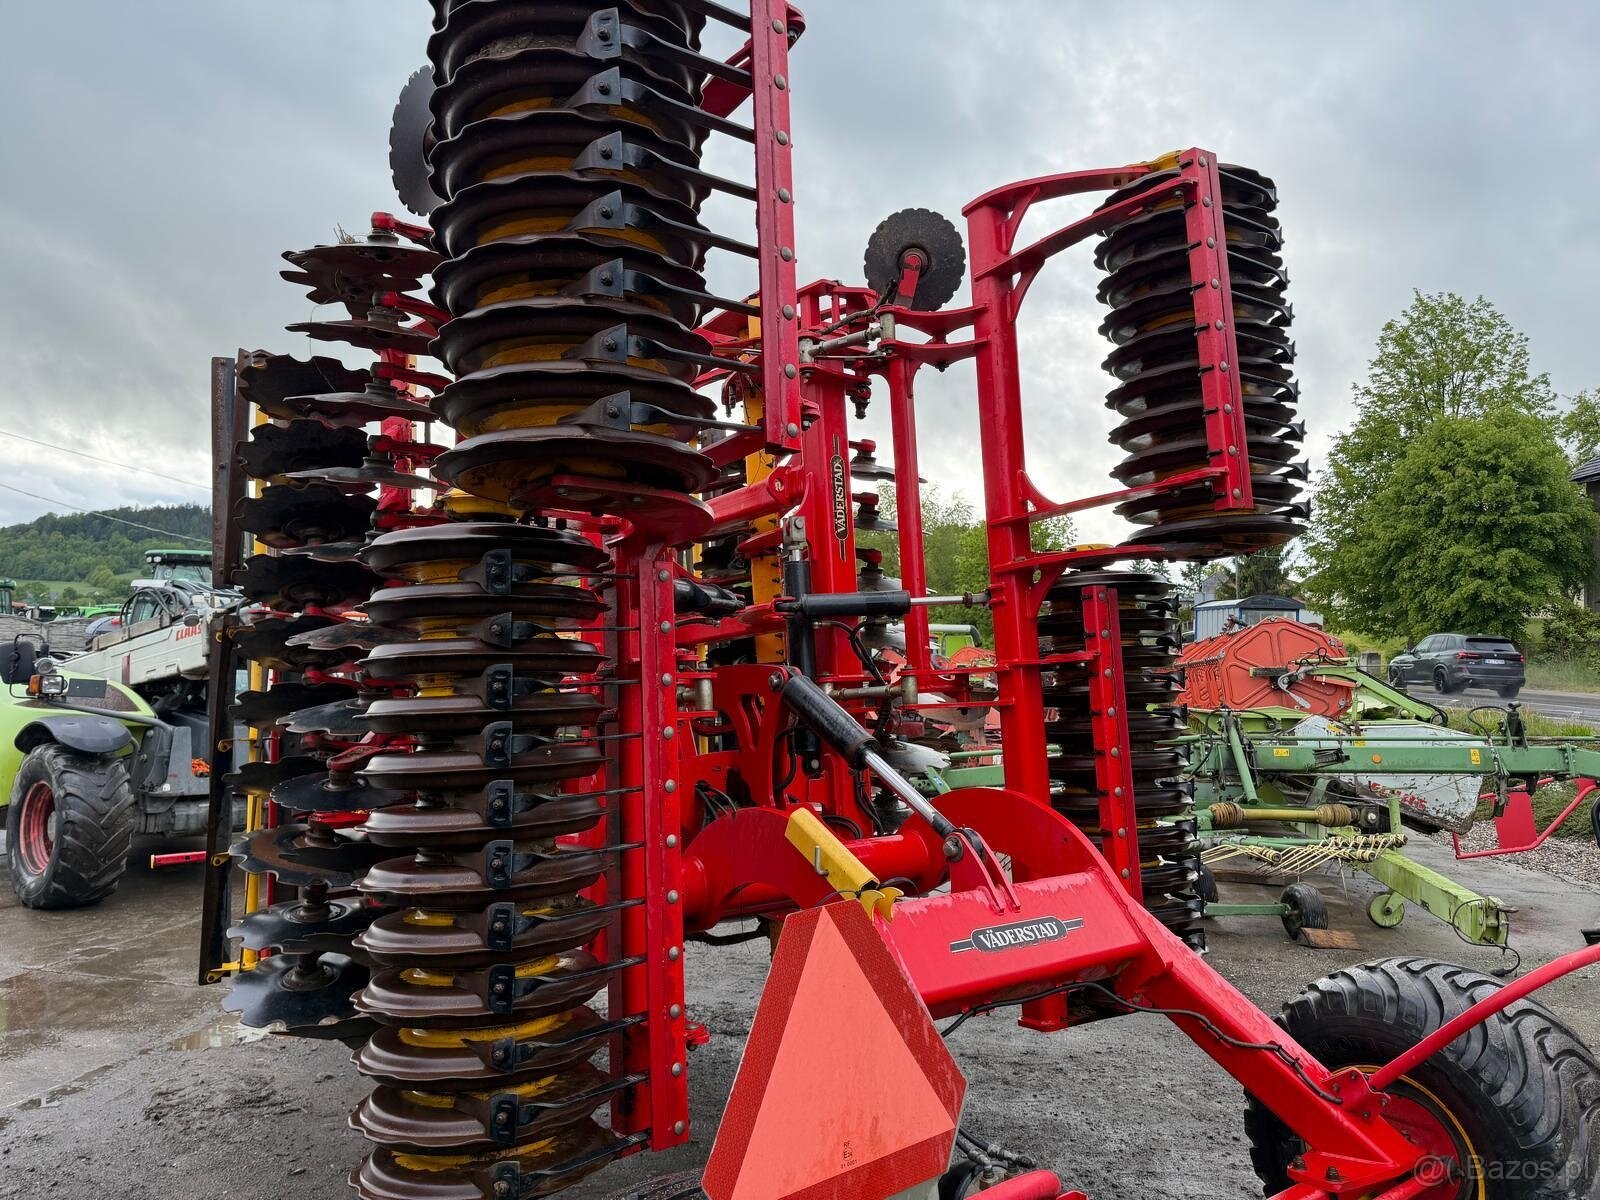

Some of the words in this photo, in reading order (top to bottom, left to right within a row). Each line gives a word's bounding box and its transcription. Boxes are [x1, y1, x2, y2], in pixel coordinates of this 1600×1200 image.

[833, 462, 846, 533] VÄDERSTAD
[176, 624, 202, 641] CLAAS
[978, 921, 1059, 949] VÄDERSTAD
